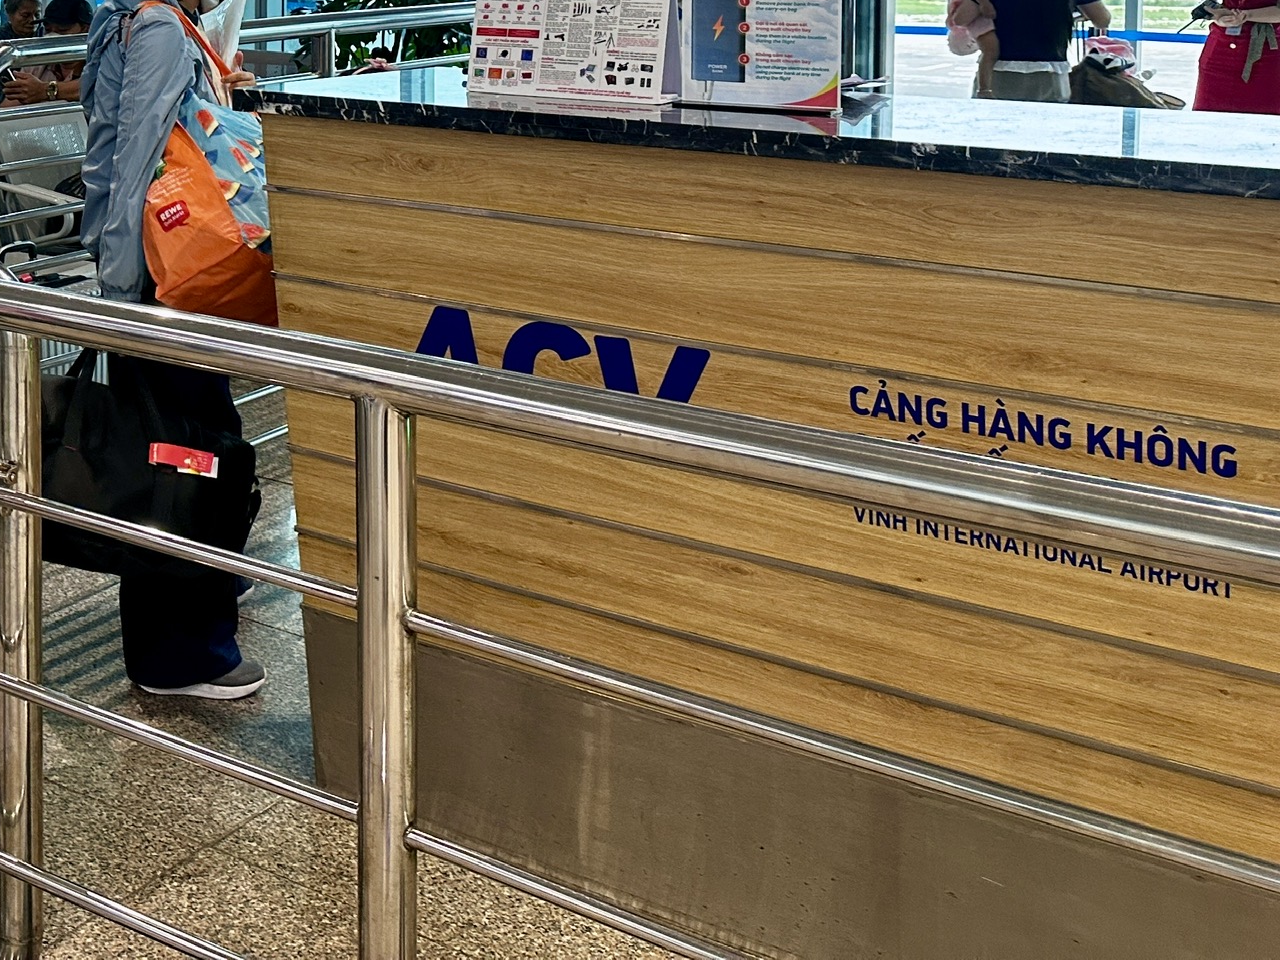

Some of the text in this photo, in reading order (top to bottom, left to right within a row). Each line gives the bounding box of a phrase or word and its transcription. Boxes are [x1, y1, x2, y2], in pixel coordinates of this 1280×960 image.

[160, 204, 182, 221] REWE
[850, 380, 948, 429] CẢNG
[961, 398, 1072, 450] HÀNG
[1087, 425, 1237, 478] KHÔNG
[853, 506, 1231, 598] VINH INTERNATIONAL AIRPORT
